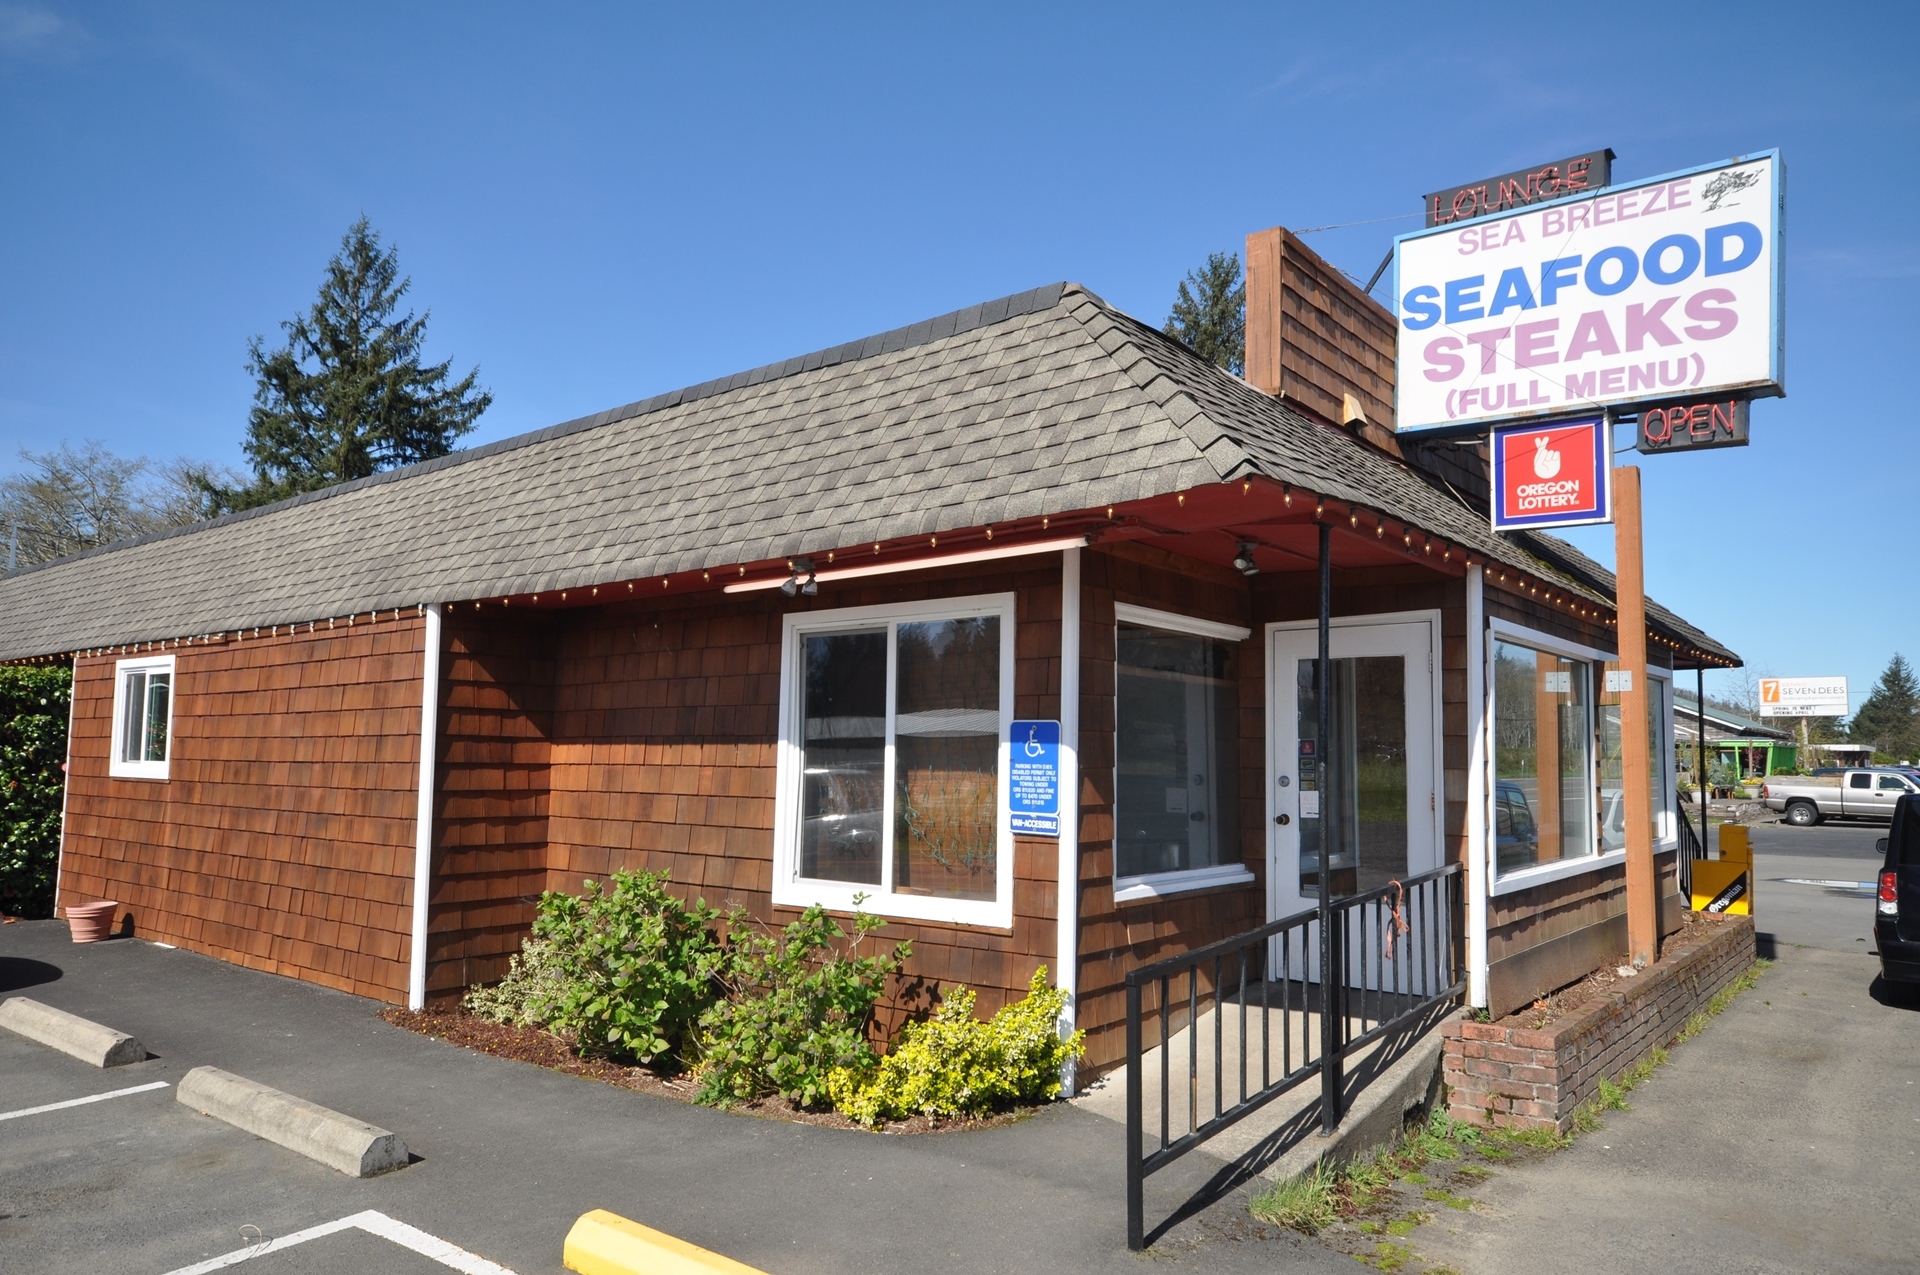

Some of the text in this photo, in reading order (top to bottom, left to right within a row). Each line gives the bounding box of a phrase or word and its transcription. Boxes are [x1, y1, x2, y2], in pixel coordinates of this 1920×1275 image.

[1434, 157, 1593, 222] LOUNGE
[1457, 178, 1692, 256] SEA BREEZE
[1402, 221, 1764, 331] SEAFOOD
[1422, 288, 1739, 383] STEAKS
[1445, 352, 1706, 419] (FULL MENU)
[1644, 400, 1736, 442] OPEN
[1516, 479, 1580, 498] OREGON
[1782, 686, 1845, 695] SEVEN DEES
[1012, 818, 1057, 829] VAN-ACCESSIBLE
[1708, 884, 1743, 913] Oregonian
